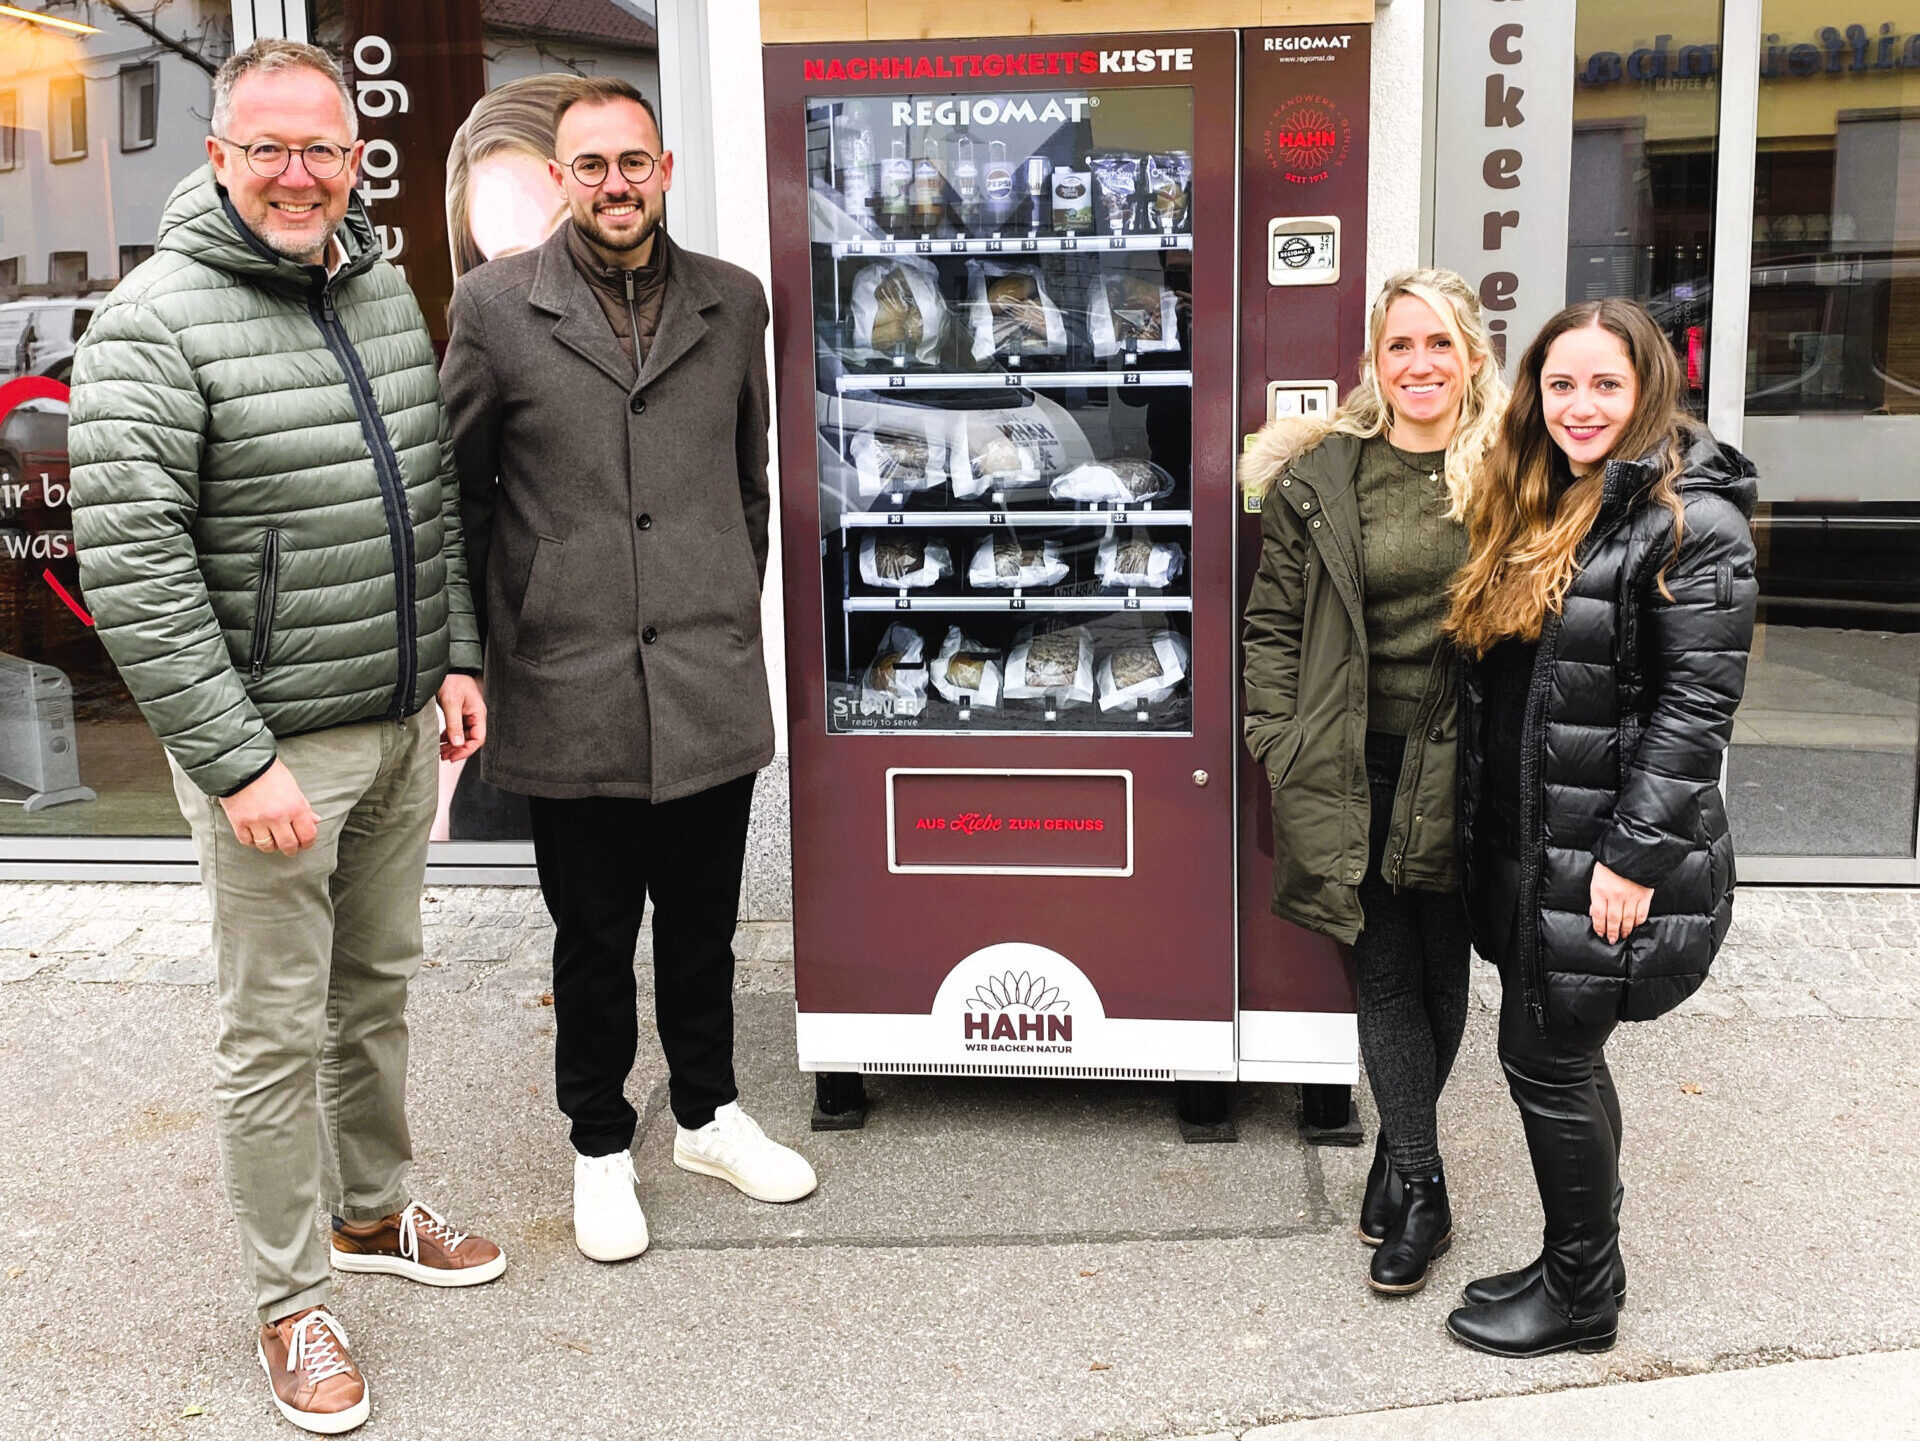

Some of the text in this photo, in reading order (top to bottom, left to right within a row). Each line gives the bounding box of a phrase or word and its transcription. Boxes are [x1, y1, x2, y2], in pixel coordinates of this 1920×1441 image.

[1264, 35, 1351, 51] REGIOMAT
[804, 48, 1194, 81] NACHHALTIGKEITSKISTE
[1279, 54, 1335, 64] www.regiomat.de
[354, 35, 409, 118] go
[1655, 78, 1701, 92] KAFFEE
[1273, 94, 1337, 118] HANDWERK
[1279, 131, 1336, 148] HAHN
[357, 139, 399, 206] to
[1285, 171, 1329, 184] SEIT 1912
[987, 180, 1011, 188] PEPSI
[1480, 0, 1525, 369] ckerei
[1320, 235, 1330, 243] 12
[40, 473, 72, 508] b
[2, 534, 69, 559] was
[851, 718, 878, 728] ready
[881, 719, 891, 727] to
[915, 812, 1105, 836] AUS Liebe ZUM GENUSS
[964, 1012, 1073, 1042] HAHN
[965, 1043, 1073, 1054] WIR BACKEN NATUR
